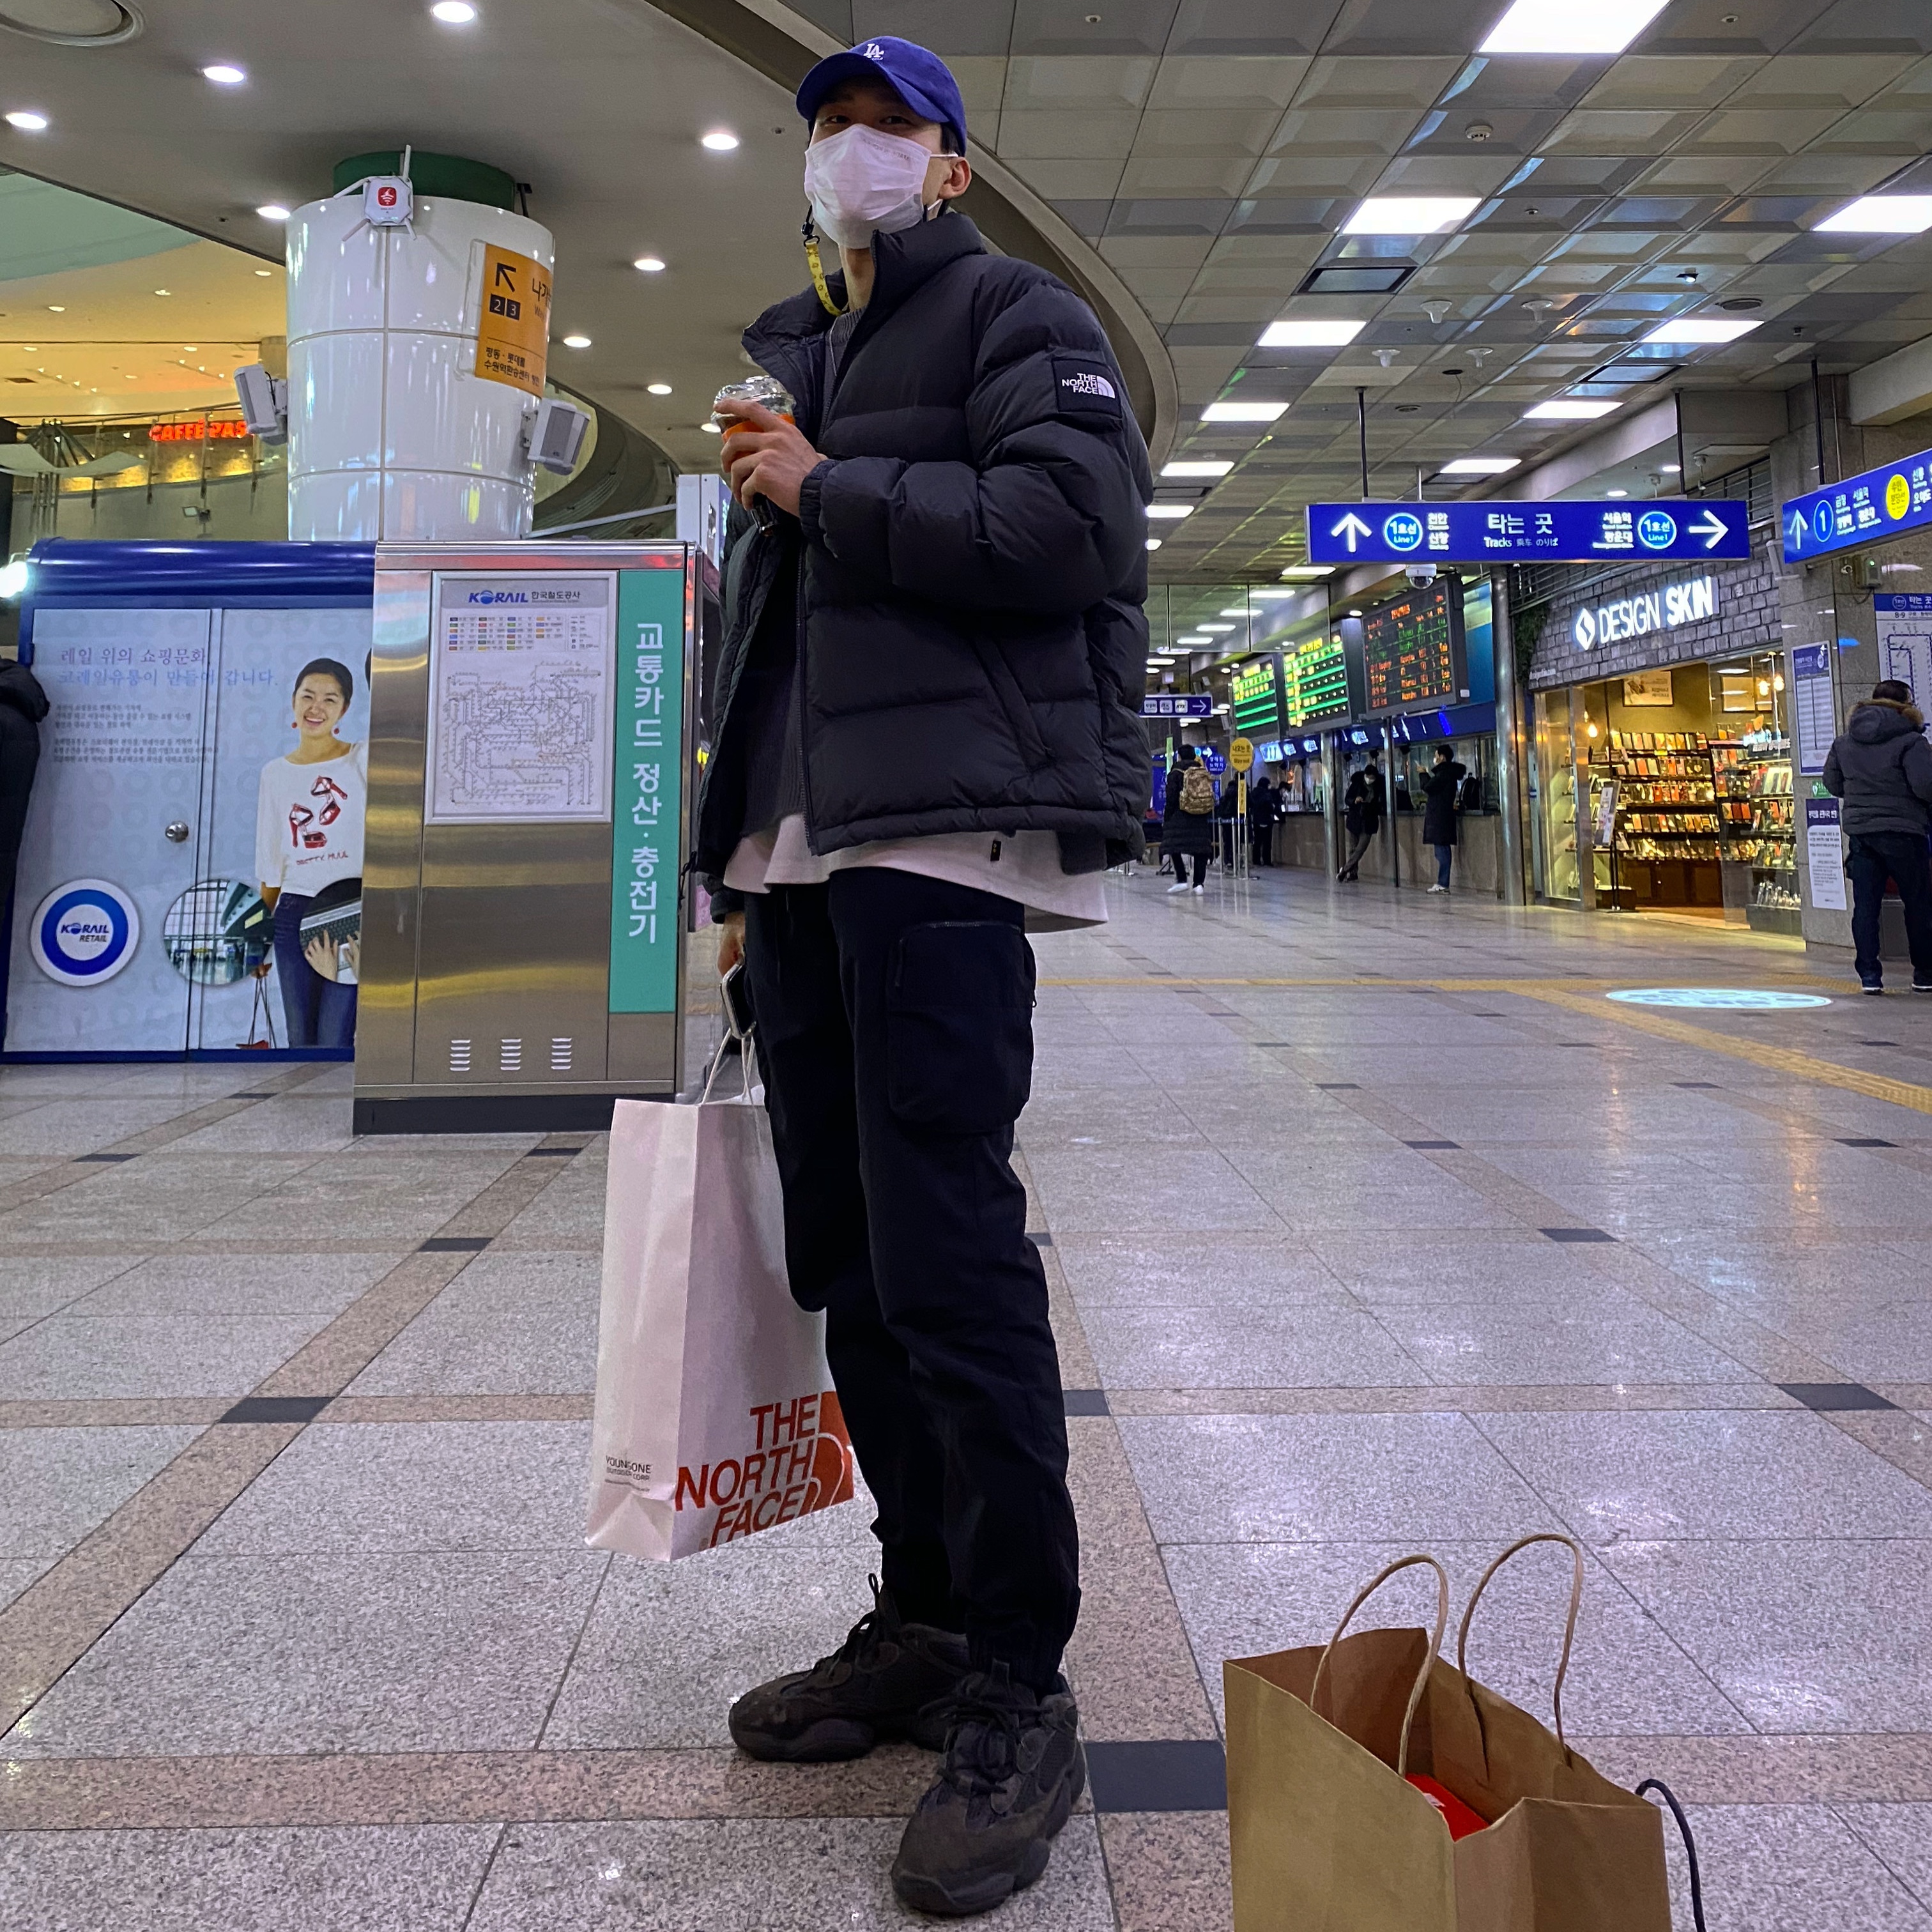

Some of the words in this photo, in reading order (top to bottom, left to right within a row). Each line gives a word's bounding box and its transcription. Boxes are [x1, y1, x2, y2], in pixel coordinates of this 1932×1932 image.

[863, 43, 884, 58] LA
[494, 300, 501, 311] 2
[510, 304, 517, 316] 3
[1061, 379, 1098, 389] NORTH
[1077, 372, 1096, 382] THE
[1073, 386, 1098, 395] FACE
[1488, 513, 1525, 534] 타는
[1535, 513, 1553, 535] 곳
[1603, 512, 1632, 524] 서울역
[1644, 519, 1670, 532] 1호선
[1820, 510, 1827, 532] 1
[1390, 520, 1416, 535] 1호선
[1483, 537, 1512, 548] Tracks
[1536, 537, 1558, 547] のりば
[468, 590, 529, 604] KORAIL
[531, 591, 581, 599] 한국철도공사
[1598, 592, 1661, 644] DESIGN
[1666, 576, 1714, 626] SKIN
[61, 647, 92, 664] 레일
[101, 647, 132, 664] 위의
[59, 670, 158, 686] 코레일유통이
[167, 670, 215, 686] 만들어
[224, 670, 278, 687] 갑니다.
[634, 623, 664, 747] 교통카드
[61, 923, 109, 935] KORAIL
[749, 1393, 818, 1450] THE
[675, 1439, 815, 1512] NORTH
[709, 1483, 806, 1549] FACE
